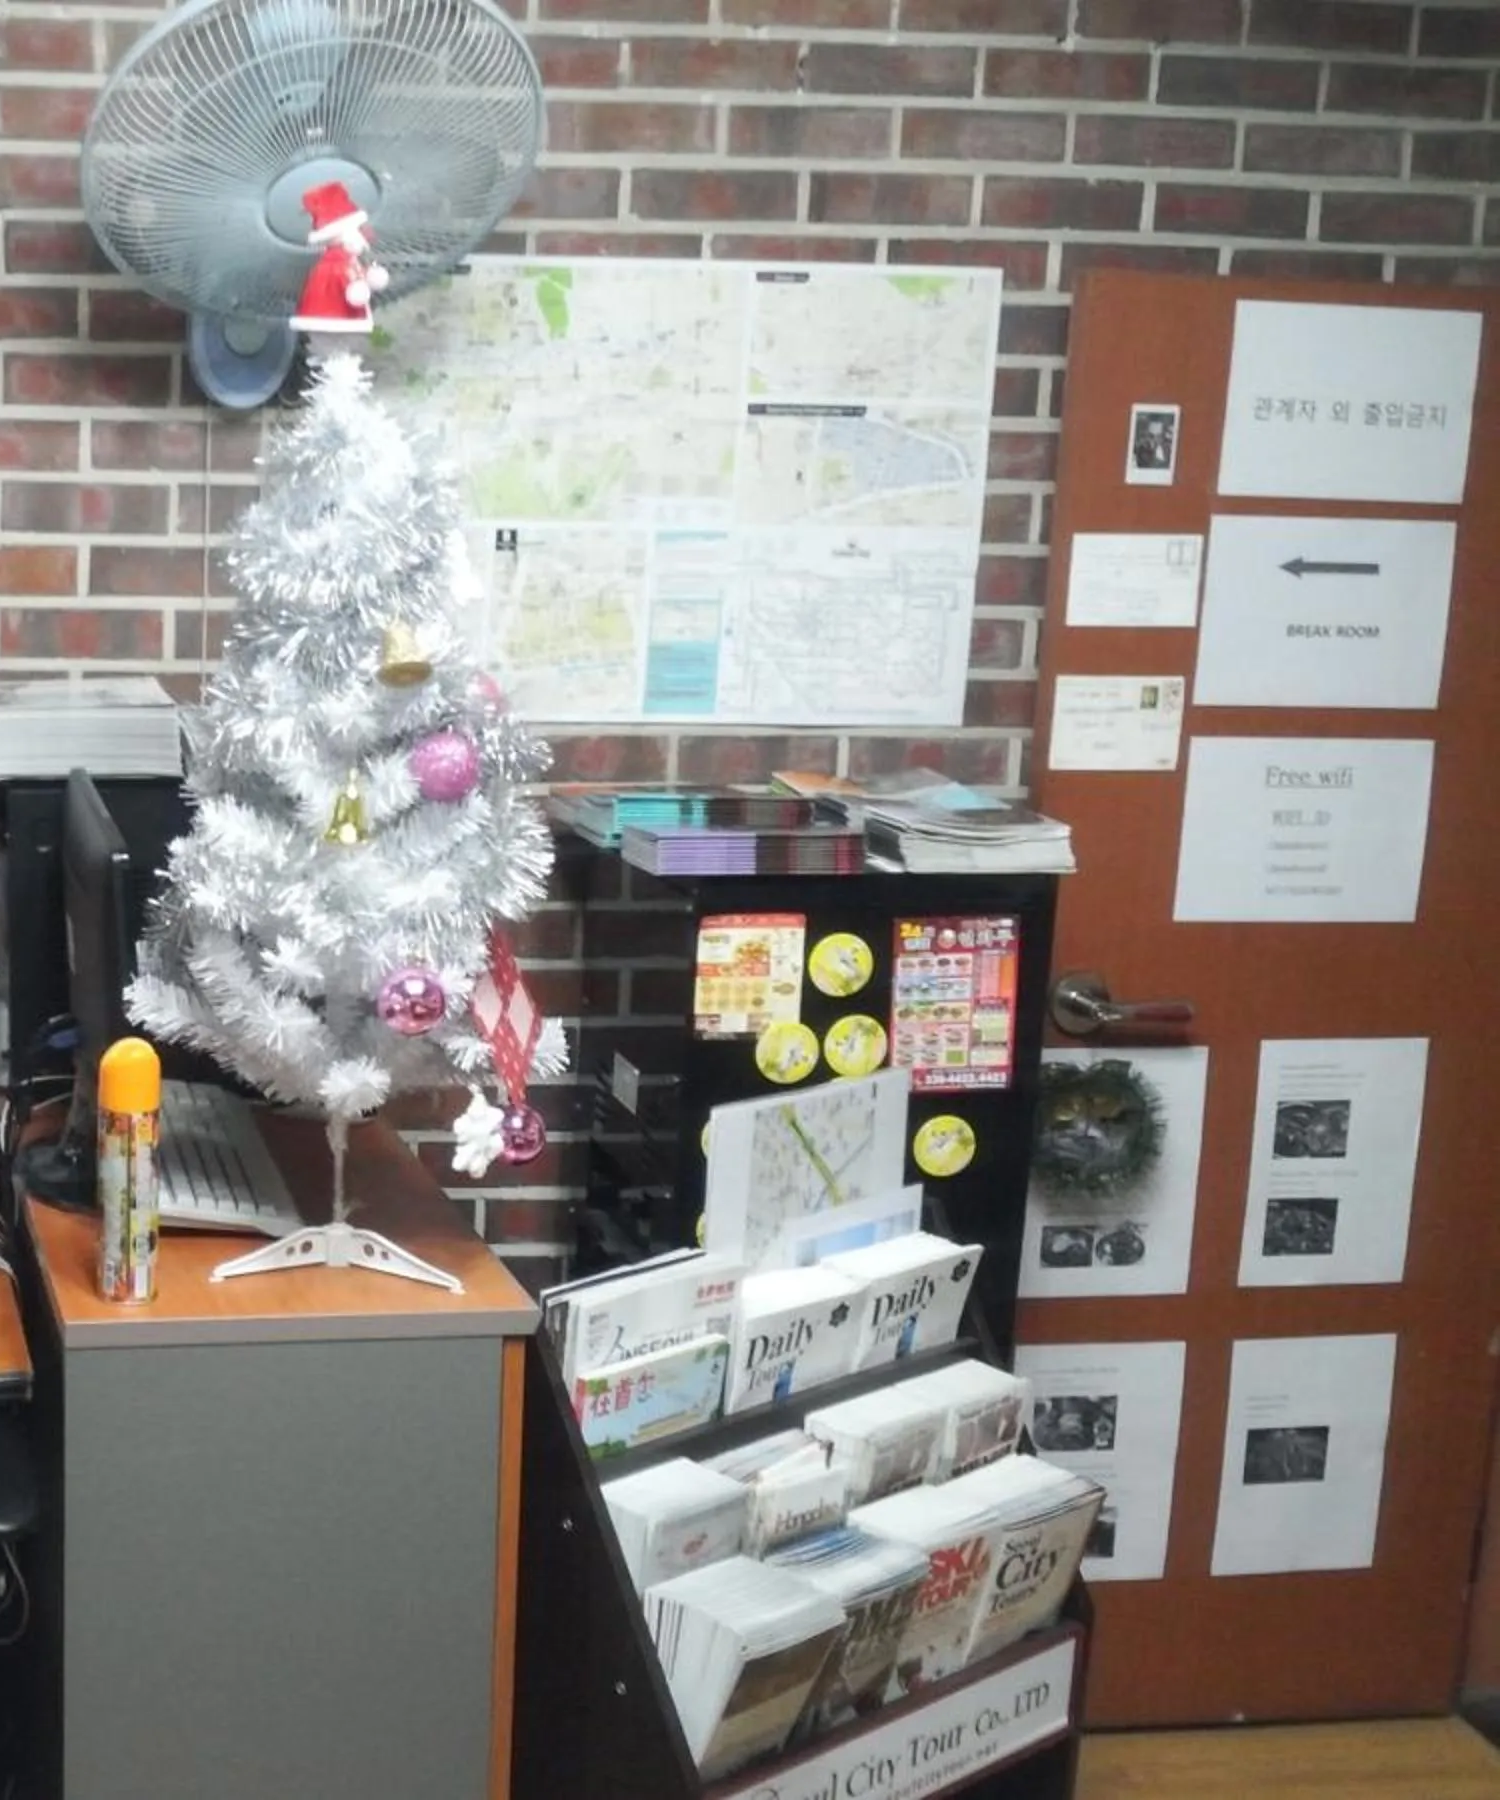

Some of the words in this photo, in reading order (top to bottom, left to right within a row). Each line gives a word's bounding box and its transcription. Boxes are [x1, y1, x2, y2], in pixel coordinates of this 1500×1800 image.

[1253, 396, 1317, 424] 관계자
[1331, 400, 1350, 425] 외
[1363, 401, 1448, 430] 출입금지
[1286, 623, 1331, 639] BREAK
[1336, 623, 1380, 639] ROOM
[1264, 764, 1312, 787] Free
[1319, 764, 1353, 787] wifi
[872, 1275, 935, 1327] Daily
[746, 1316, 813, 1370] Daily
[996, 1548, 1058, 1591] City
[846, 1754, 900, 1799] City
[907, 1725, 967, 1768] Tour
[1013, 1681, 1051, 1720] LTD
